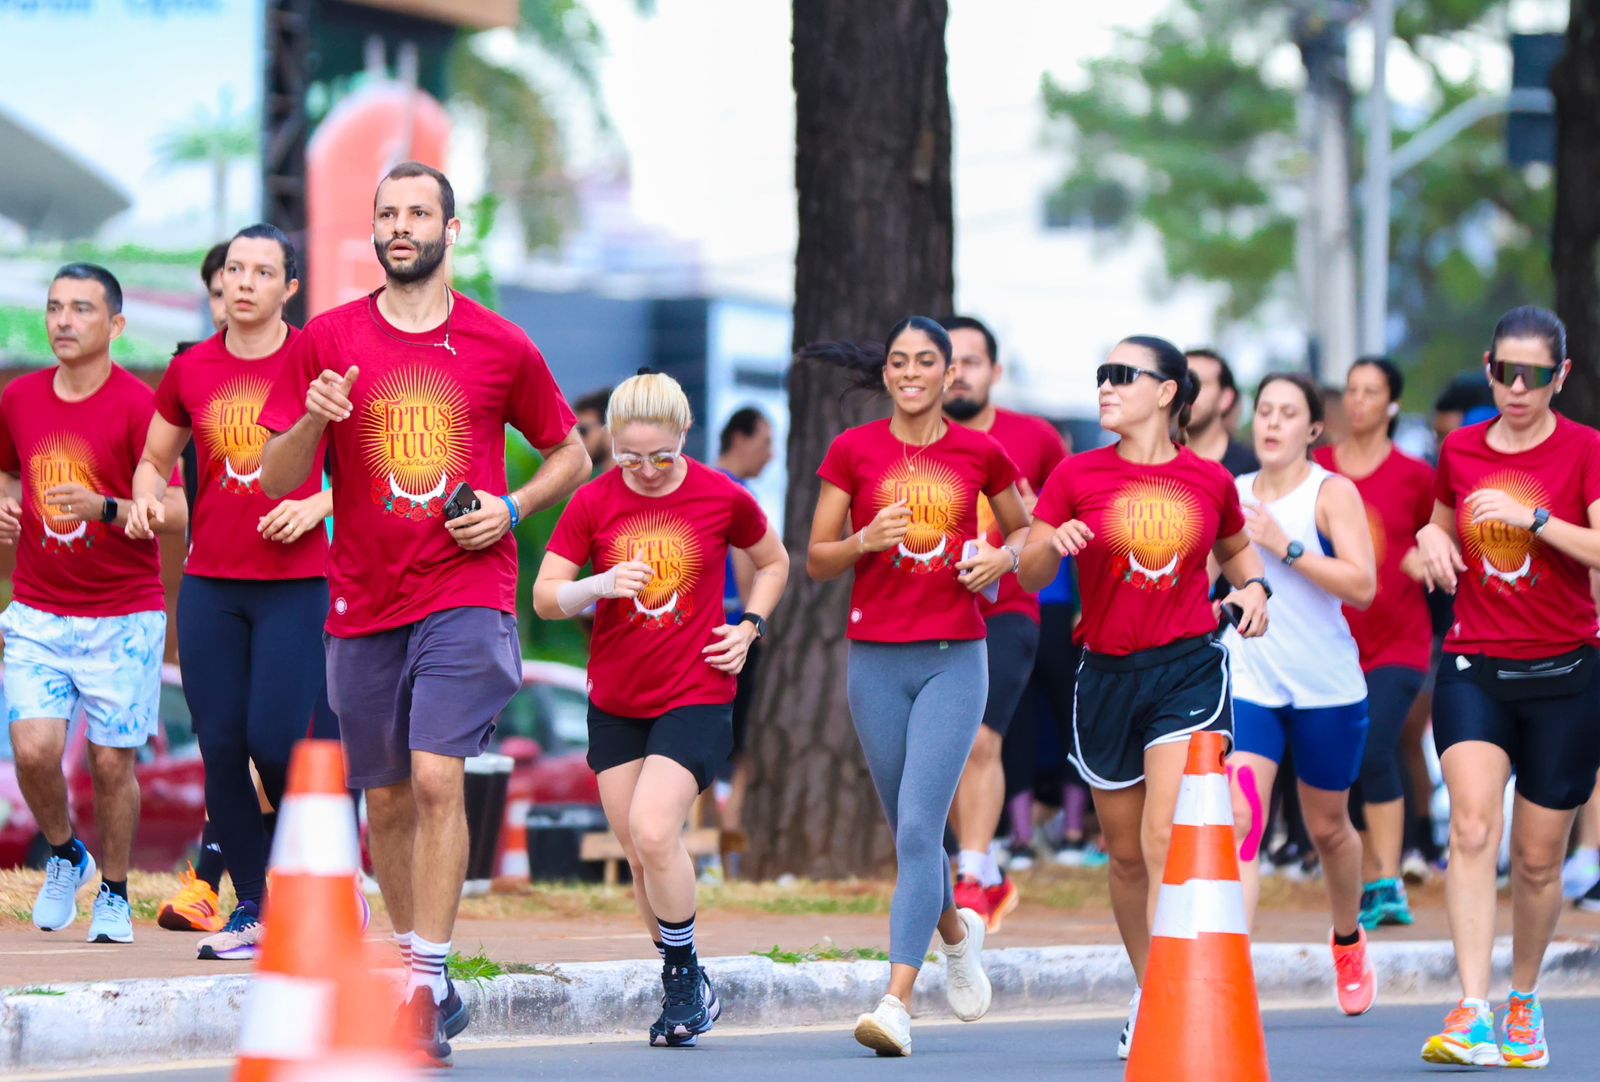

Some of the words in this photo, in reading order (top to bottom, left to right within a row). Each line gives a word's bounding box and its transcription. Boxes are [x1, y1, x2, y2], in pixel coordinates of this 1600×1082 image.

[209, 397, 261, 425] TOTU
[371, 396, 451, 432] TOTUS
[386, 433, 448, 459] TUUS
[909, 505, 949, 525] UUS
[1114, 495, 1186, 520] TOTUS
[1127, 520, 1183, 541] TUUS
